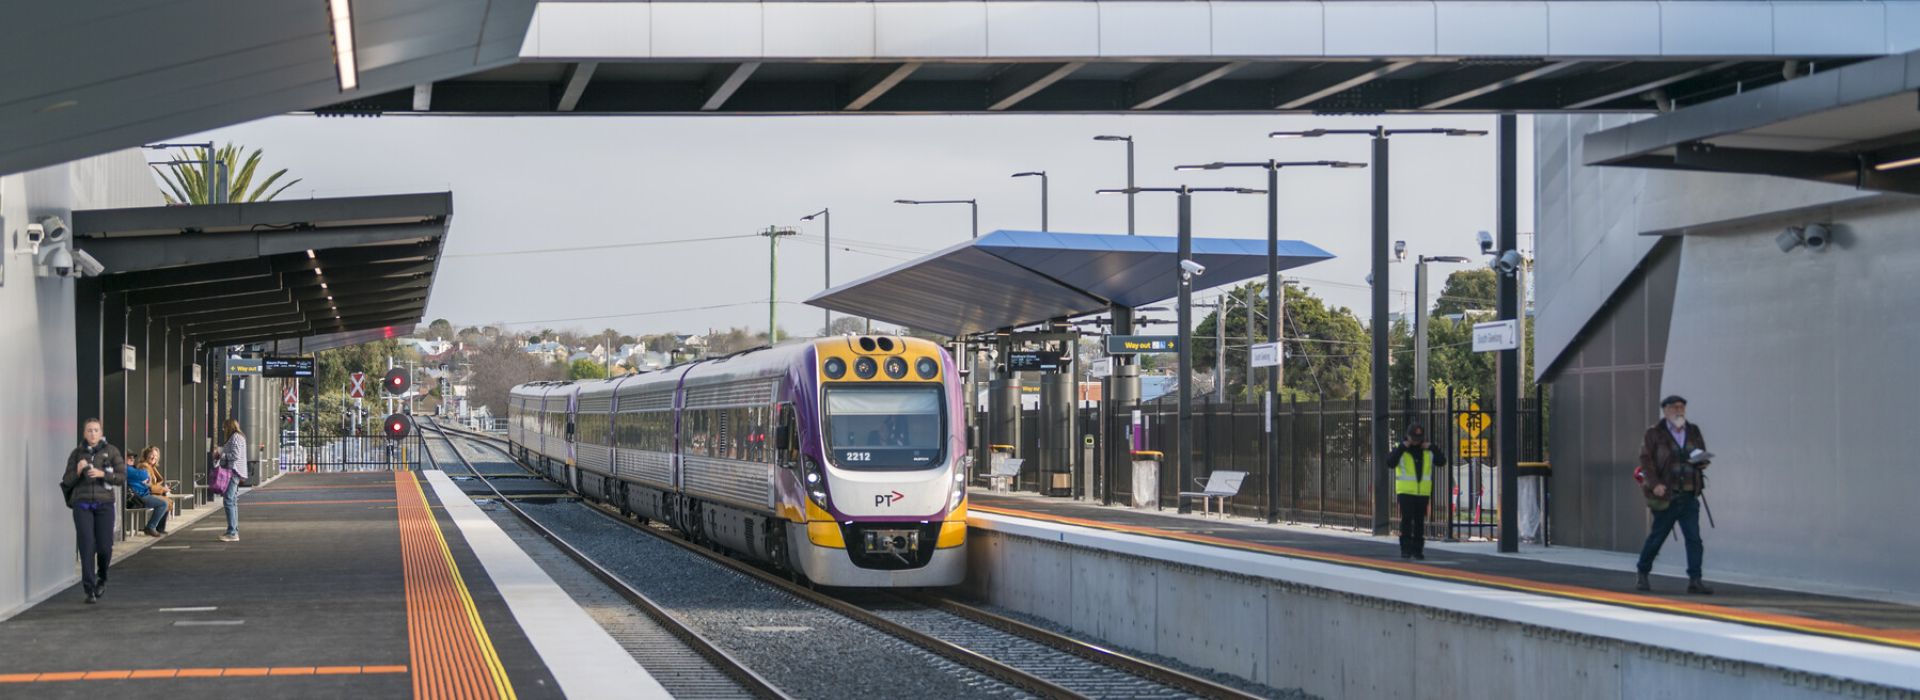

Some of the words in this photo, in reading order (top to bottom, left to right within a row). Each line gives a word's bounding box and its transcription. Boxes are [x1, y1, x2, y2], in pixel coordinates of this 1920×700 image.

[1124, 341, 1139, 350] Way
[1140, 341, 1151, 349] out
[846, 452, 871, 461] 2212
